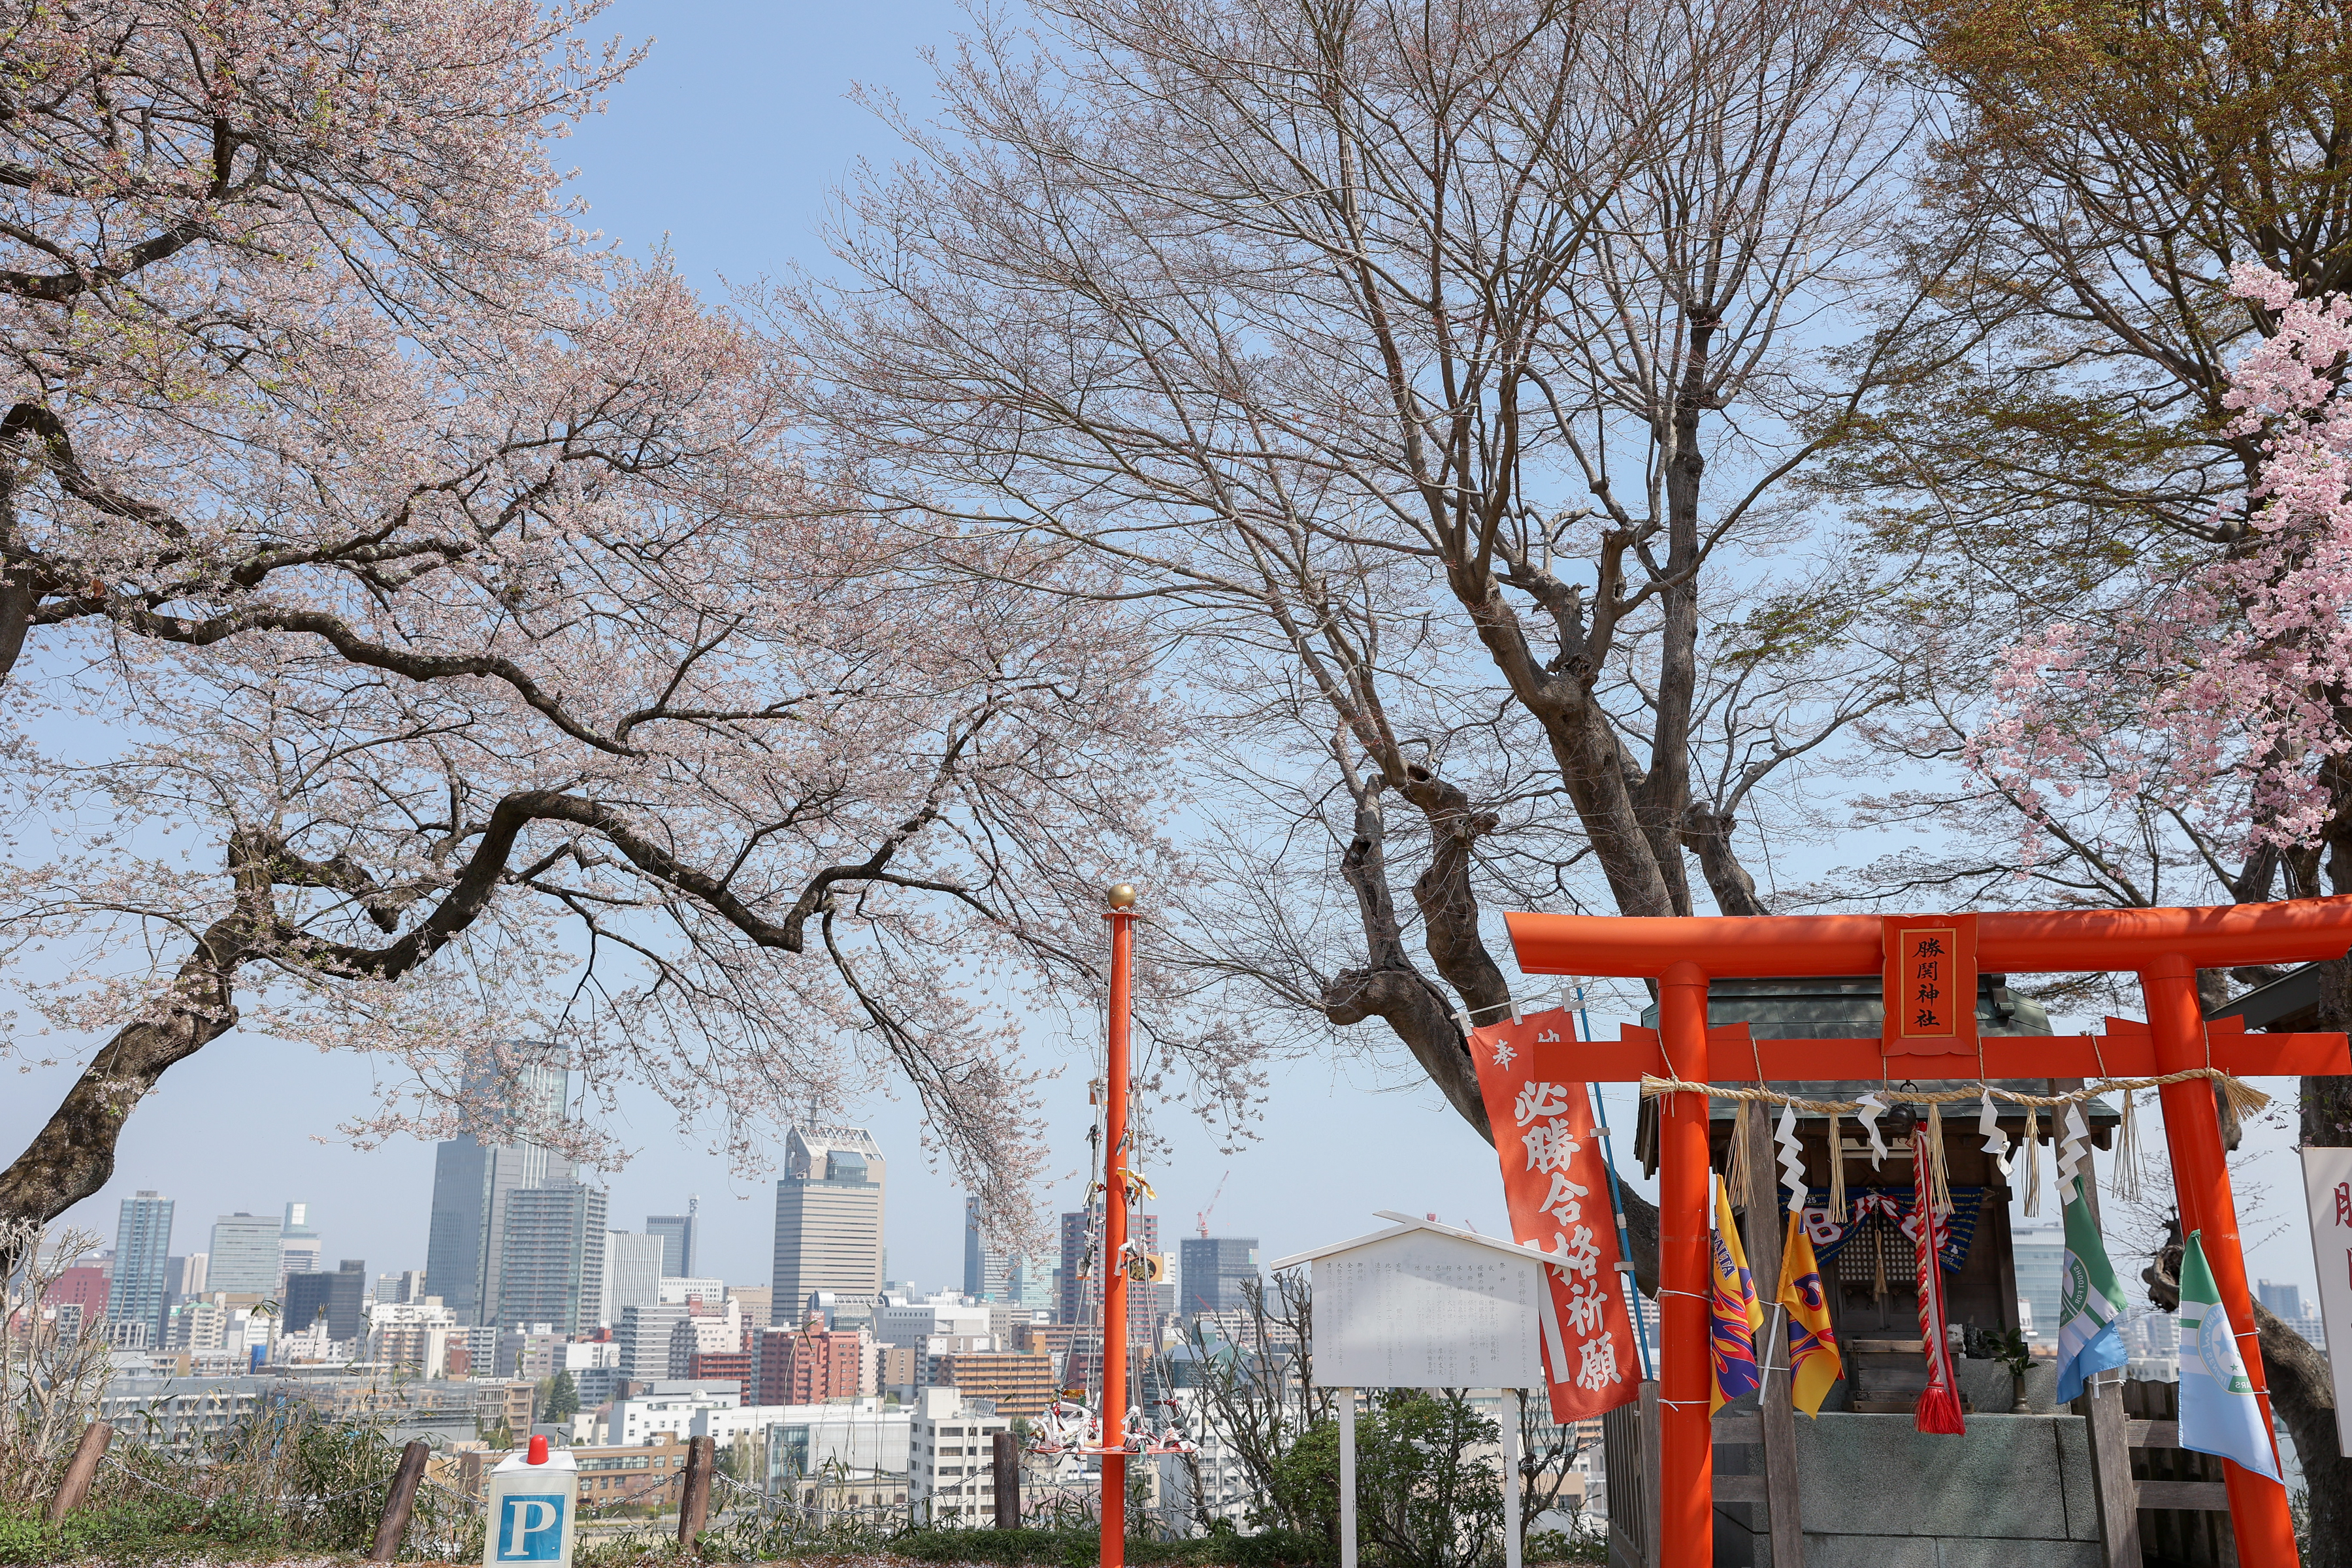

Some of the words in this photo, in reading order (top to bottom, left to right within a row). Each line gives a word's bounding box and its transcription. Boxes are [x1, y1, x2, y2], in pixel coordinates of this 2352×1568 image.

[1912, 938, 1945, 1028] 勝鬨神社
[1514, 1080, 1622, 1392] 必勝合格祈願
[1714, 1214, 1737, 1281] GALTA
[504, 1501, 557, 1556] P
